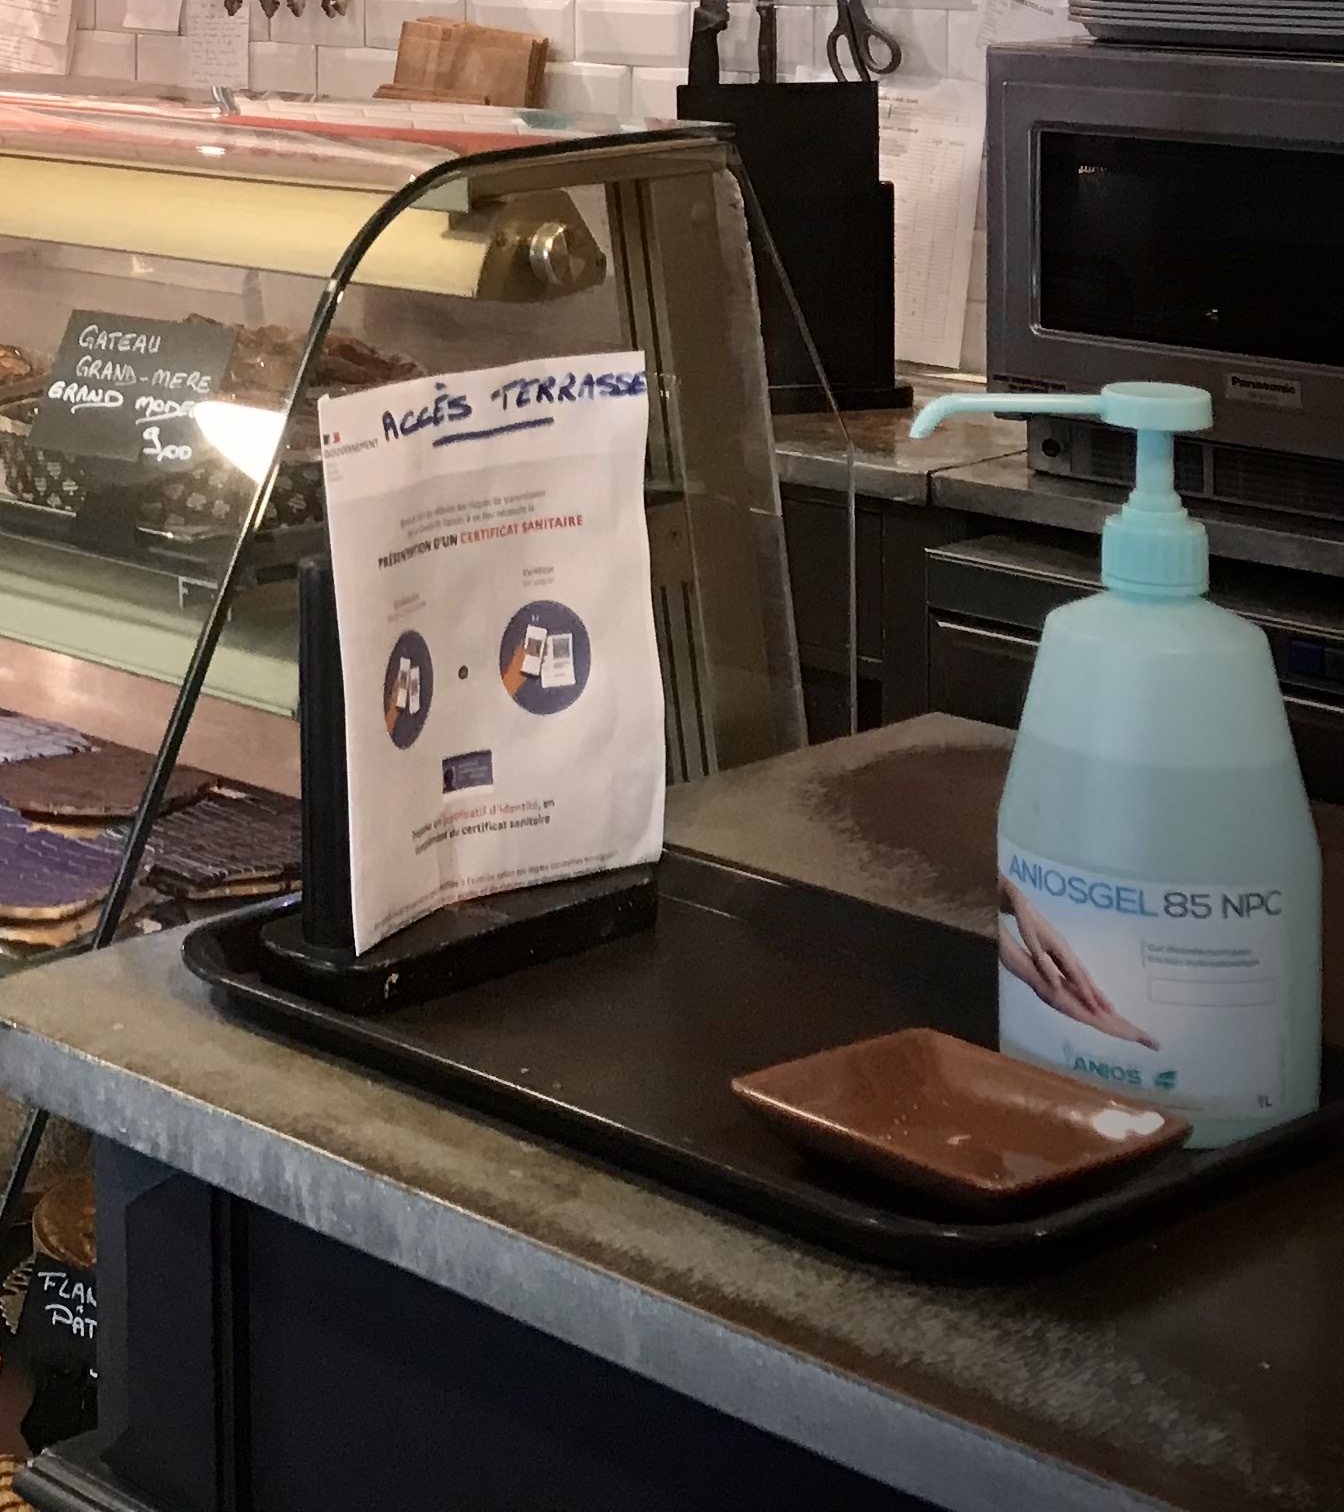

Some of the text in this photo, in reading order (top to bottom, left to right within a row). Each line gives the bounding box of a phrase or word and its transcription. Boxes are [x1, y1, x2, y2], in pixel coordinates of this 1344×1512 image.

[79, 325, 161, 354] GATEAU
[381, 371, 647, 441] ACCÈS TERRASSE
[461, 523, 519, 544] CERTIFICAT
[522, 514, 583, 533] SANITAIRE
[1009, 854, 1283, 919] ANIOSGEL 85 NPC
[1072, 1057, 1142, 1085] ANIOS
